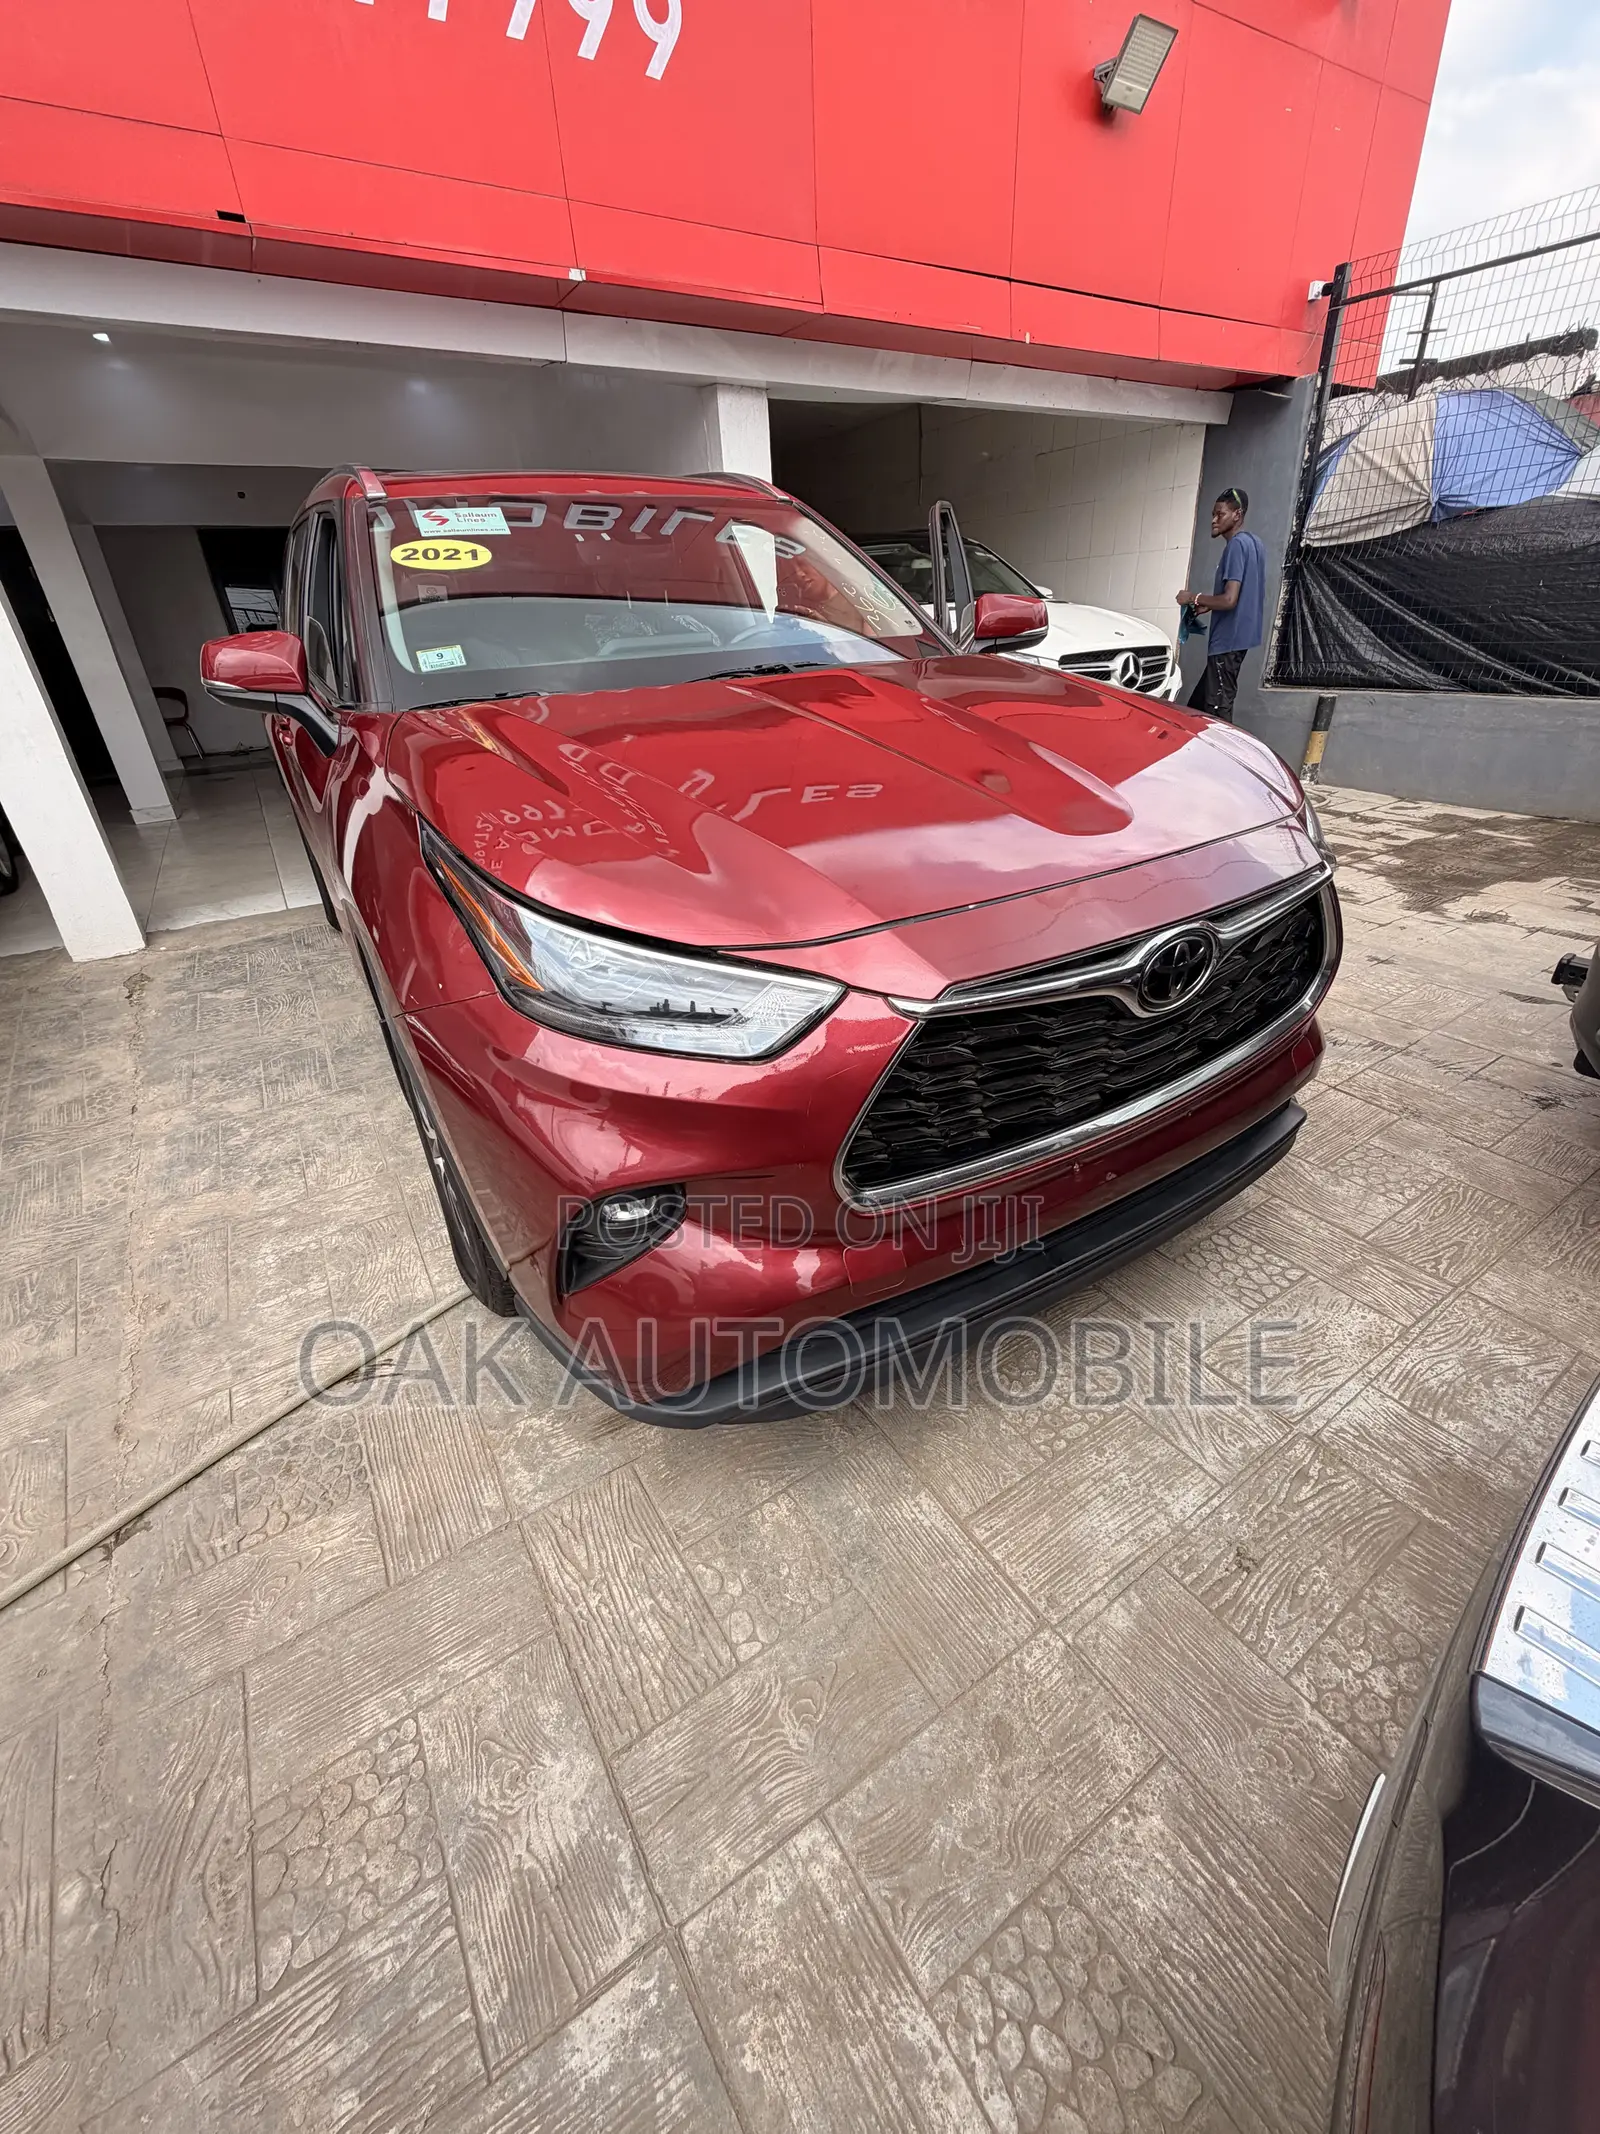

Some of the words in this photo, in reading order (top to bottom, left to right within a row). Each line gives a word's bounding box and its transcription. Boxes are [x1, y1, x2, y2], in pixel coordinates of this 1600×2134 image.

[454, 511, 498, 519] Sallaum
[400, 548, 479, 561] 2021
[436, 652, 444, 660] 9
